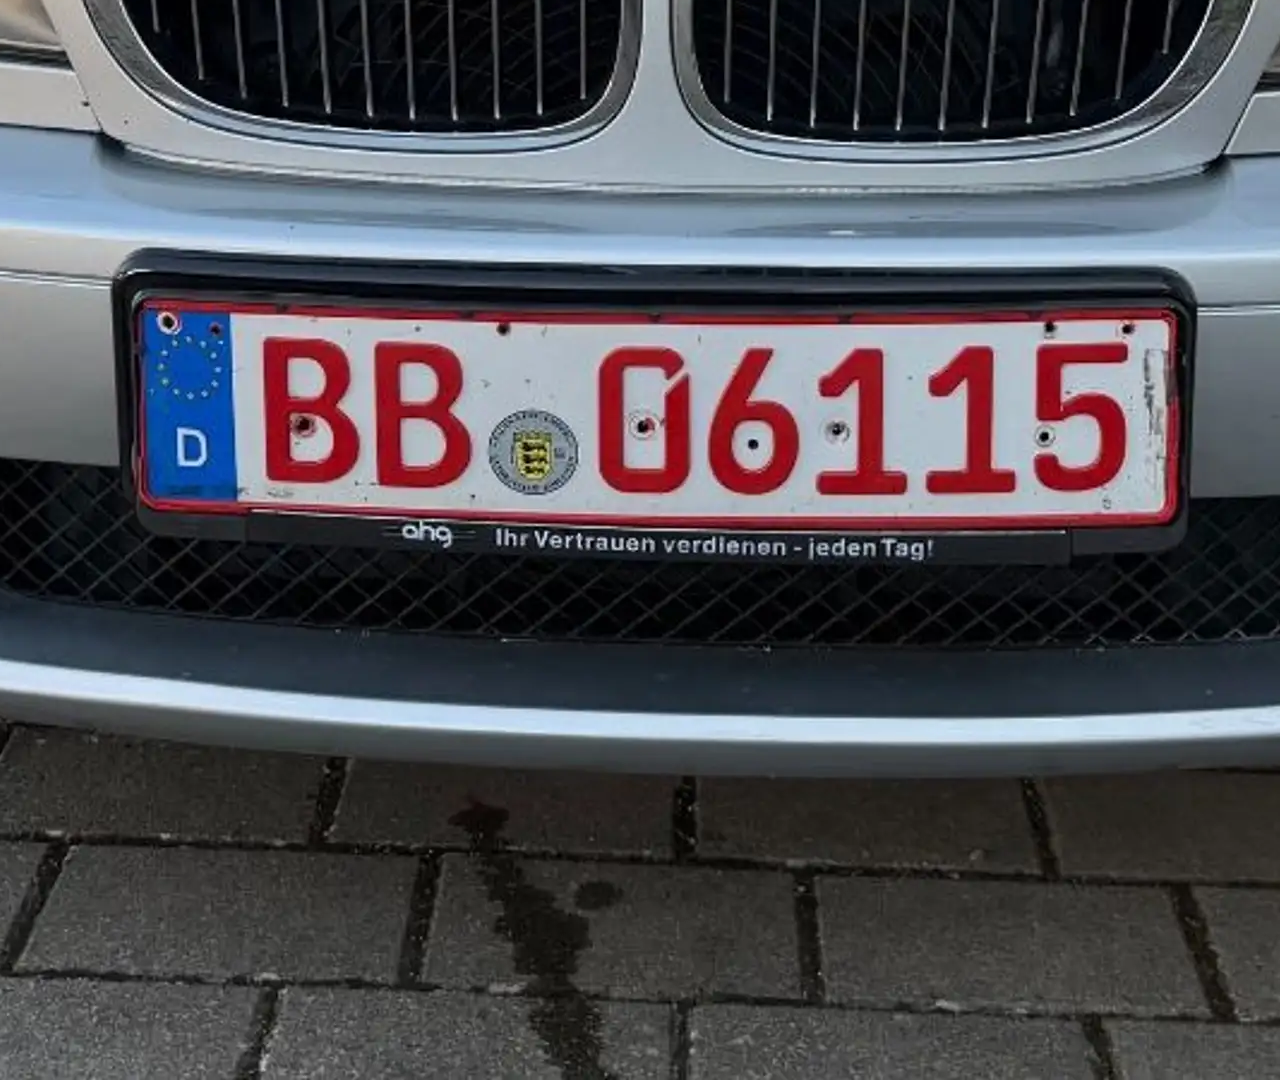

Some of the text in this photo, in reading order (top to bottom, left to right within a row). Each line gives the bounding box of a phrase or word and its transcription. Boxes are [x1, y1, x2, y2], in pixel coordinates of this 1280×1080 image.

[263, 336, 472, 488] BB
[598, 343, 1129, 496] 06115
[176, 427, 207, 467] D
[401, 519, 453, 549] ahg
[495, 528, 528, 548] Ihr
[534, 529, 656, 553] Vertrauen
[663, 535, 787, 557] verdienen
[807, 537, 877, 561] jeden
[880, 537, 935, 562] Tag!
